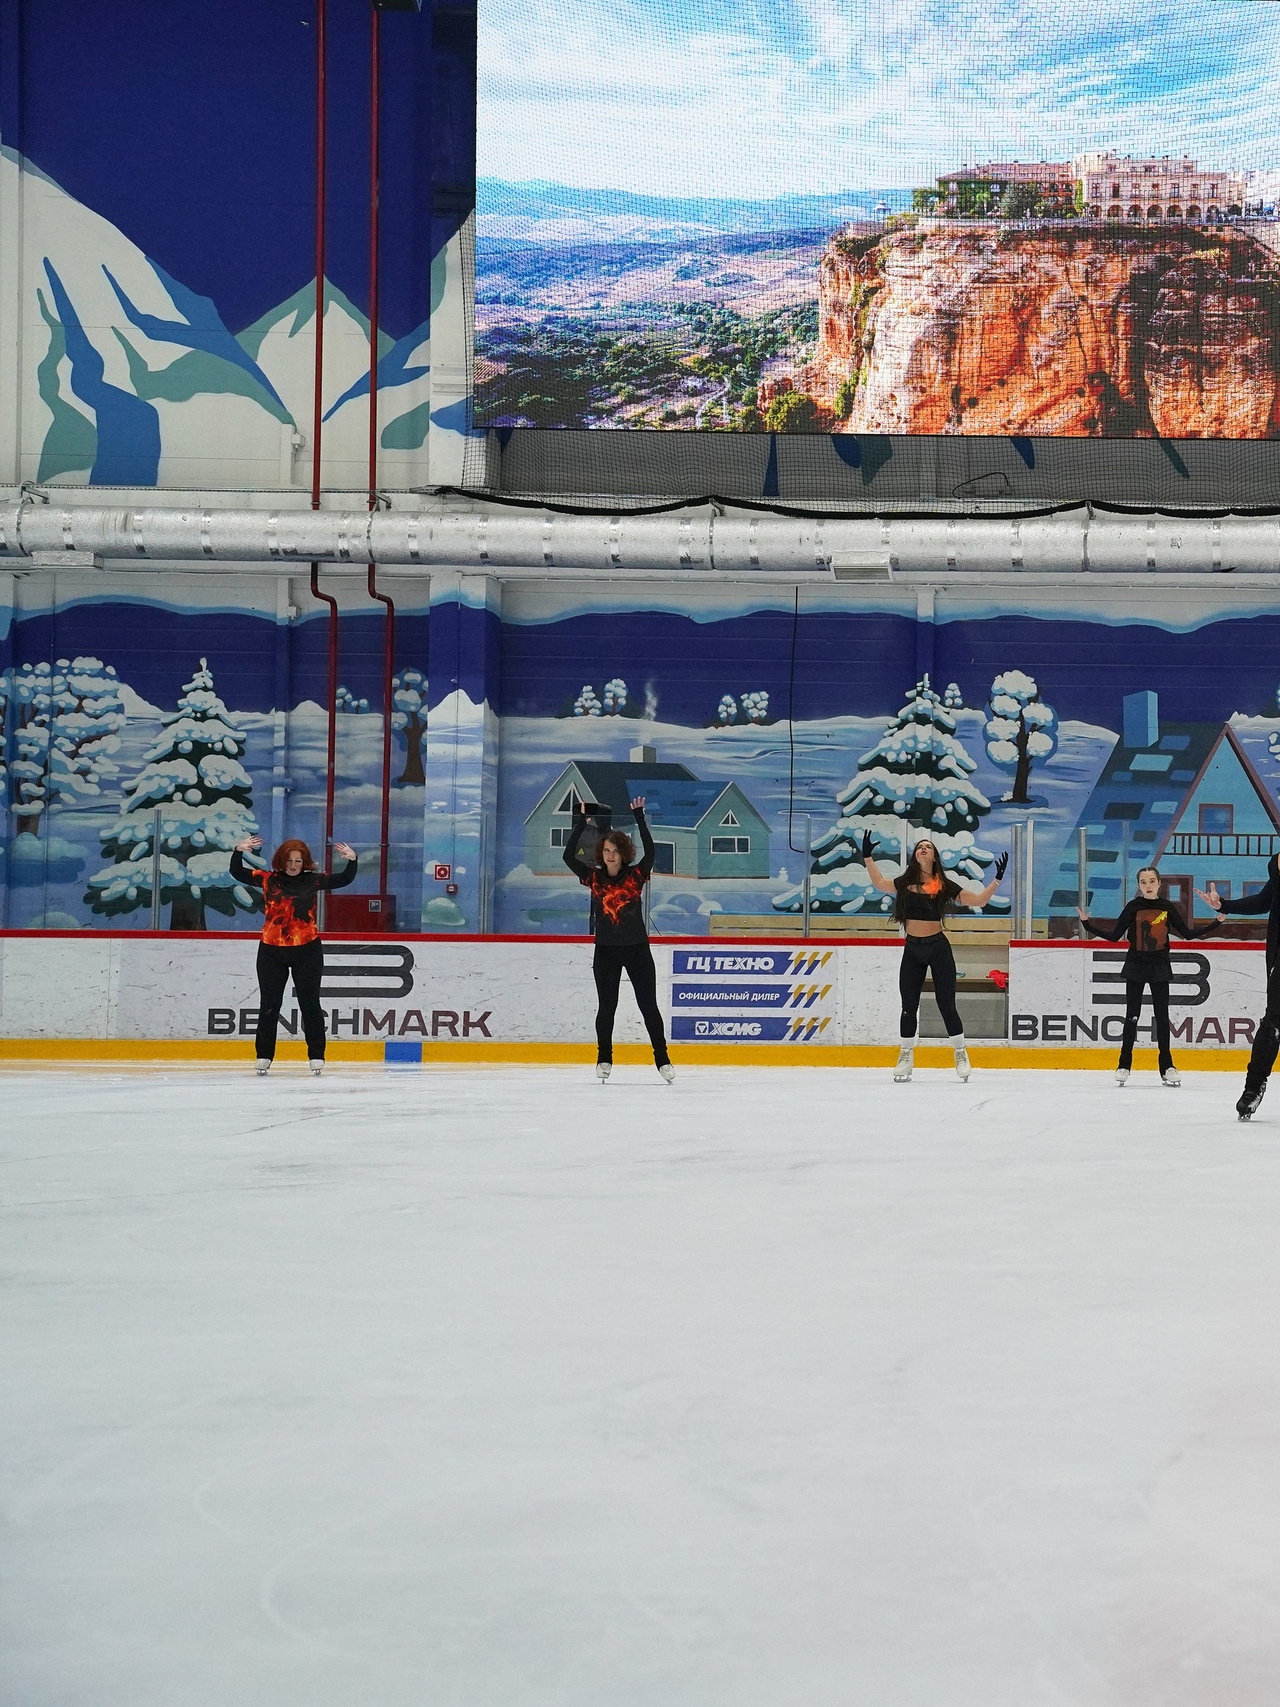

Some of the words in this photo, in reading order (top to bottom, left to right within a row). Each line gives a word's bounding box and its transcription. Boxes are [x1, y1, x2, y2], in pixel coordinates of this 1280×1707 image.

[687, 956, 711, 973] ГЦ
[714, 957, 775, 971] ТЕХНО
[678, 991, 750, 1001] ОФИЦИАЛЬНЫЙ
[751, 993, 780, 1001] ДИЛЕР
[709, 1022, 763, 1036] XCMG
